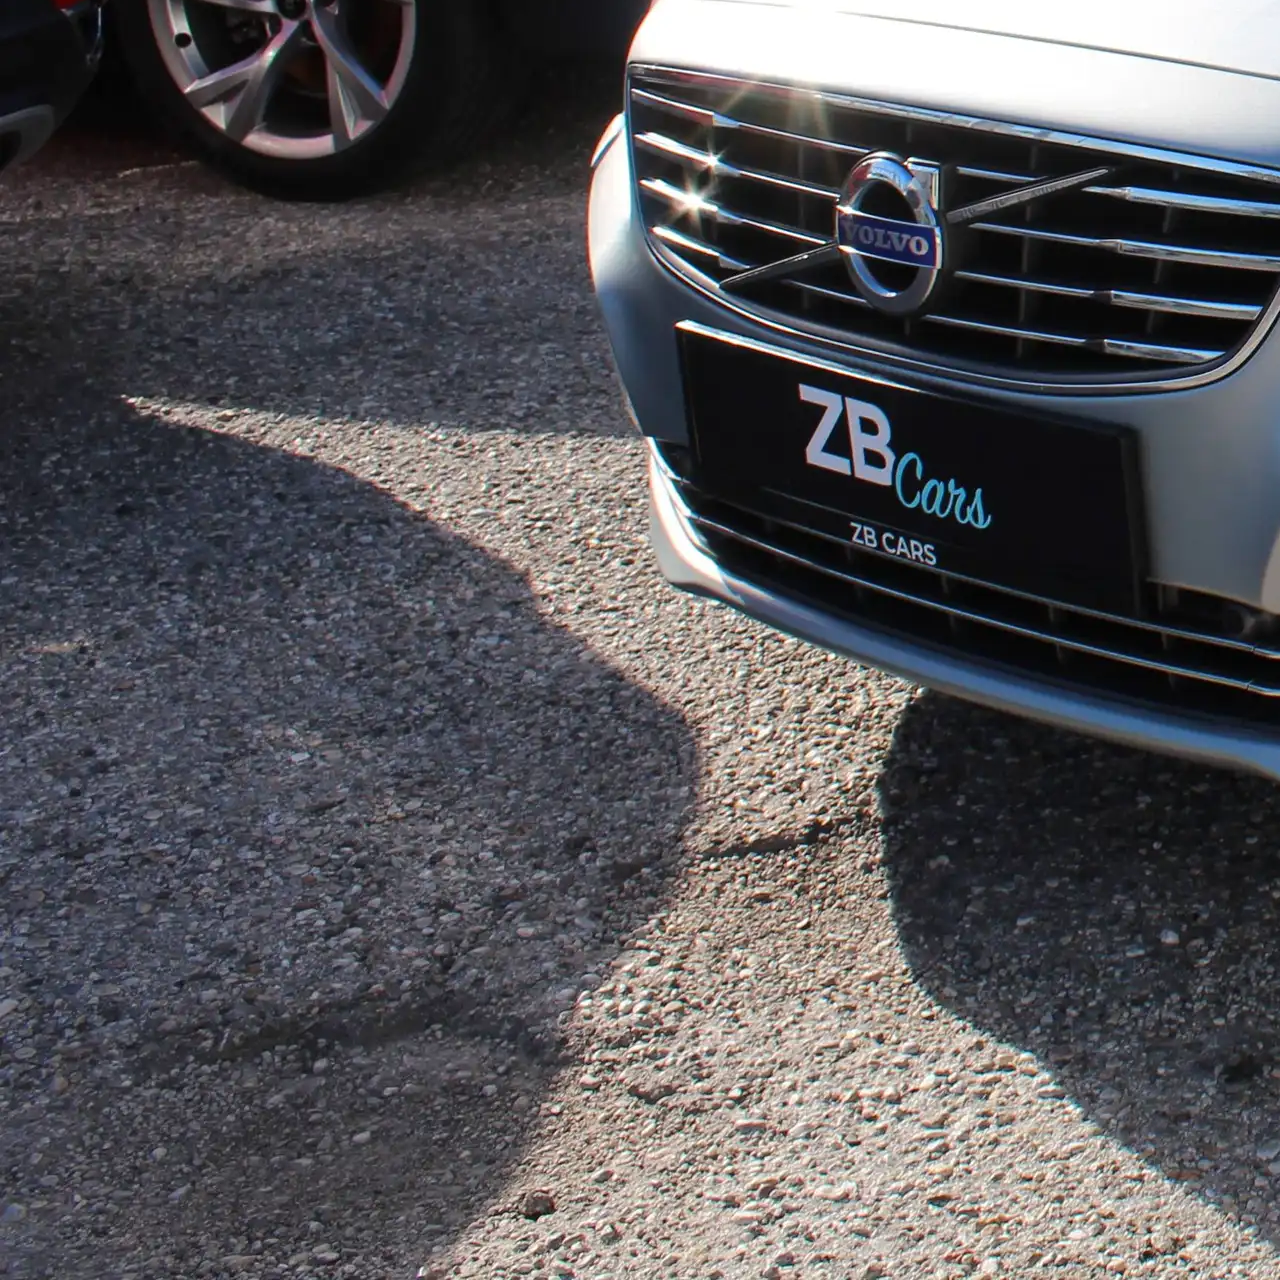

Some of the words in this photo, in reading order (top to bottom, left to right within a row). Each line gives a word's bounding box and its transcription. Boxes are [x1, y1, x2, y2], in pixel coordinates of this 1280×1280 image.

[842, 220, 929, 256] VOLVO
[799, 383, 895, 486] ZB
[895, 453, 992, 529] Cars
[849, 521, 878, 548] ZB
[881, 532, 937, 566] CARS
